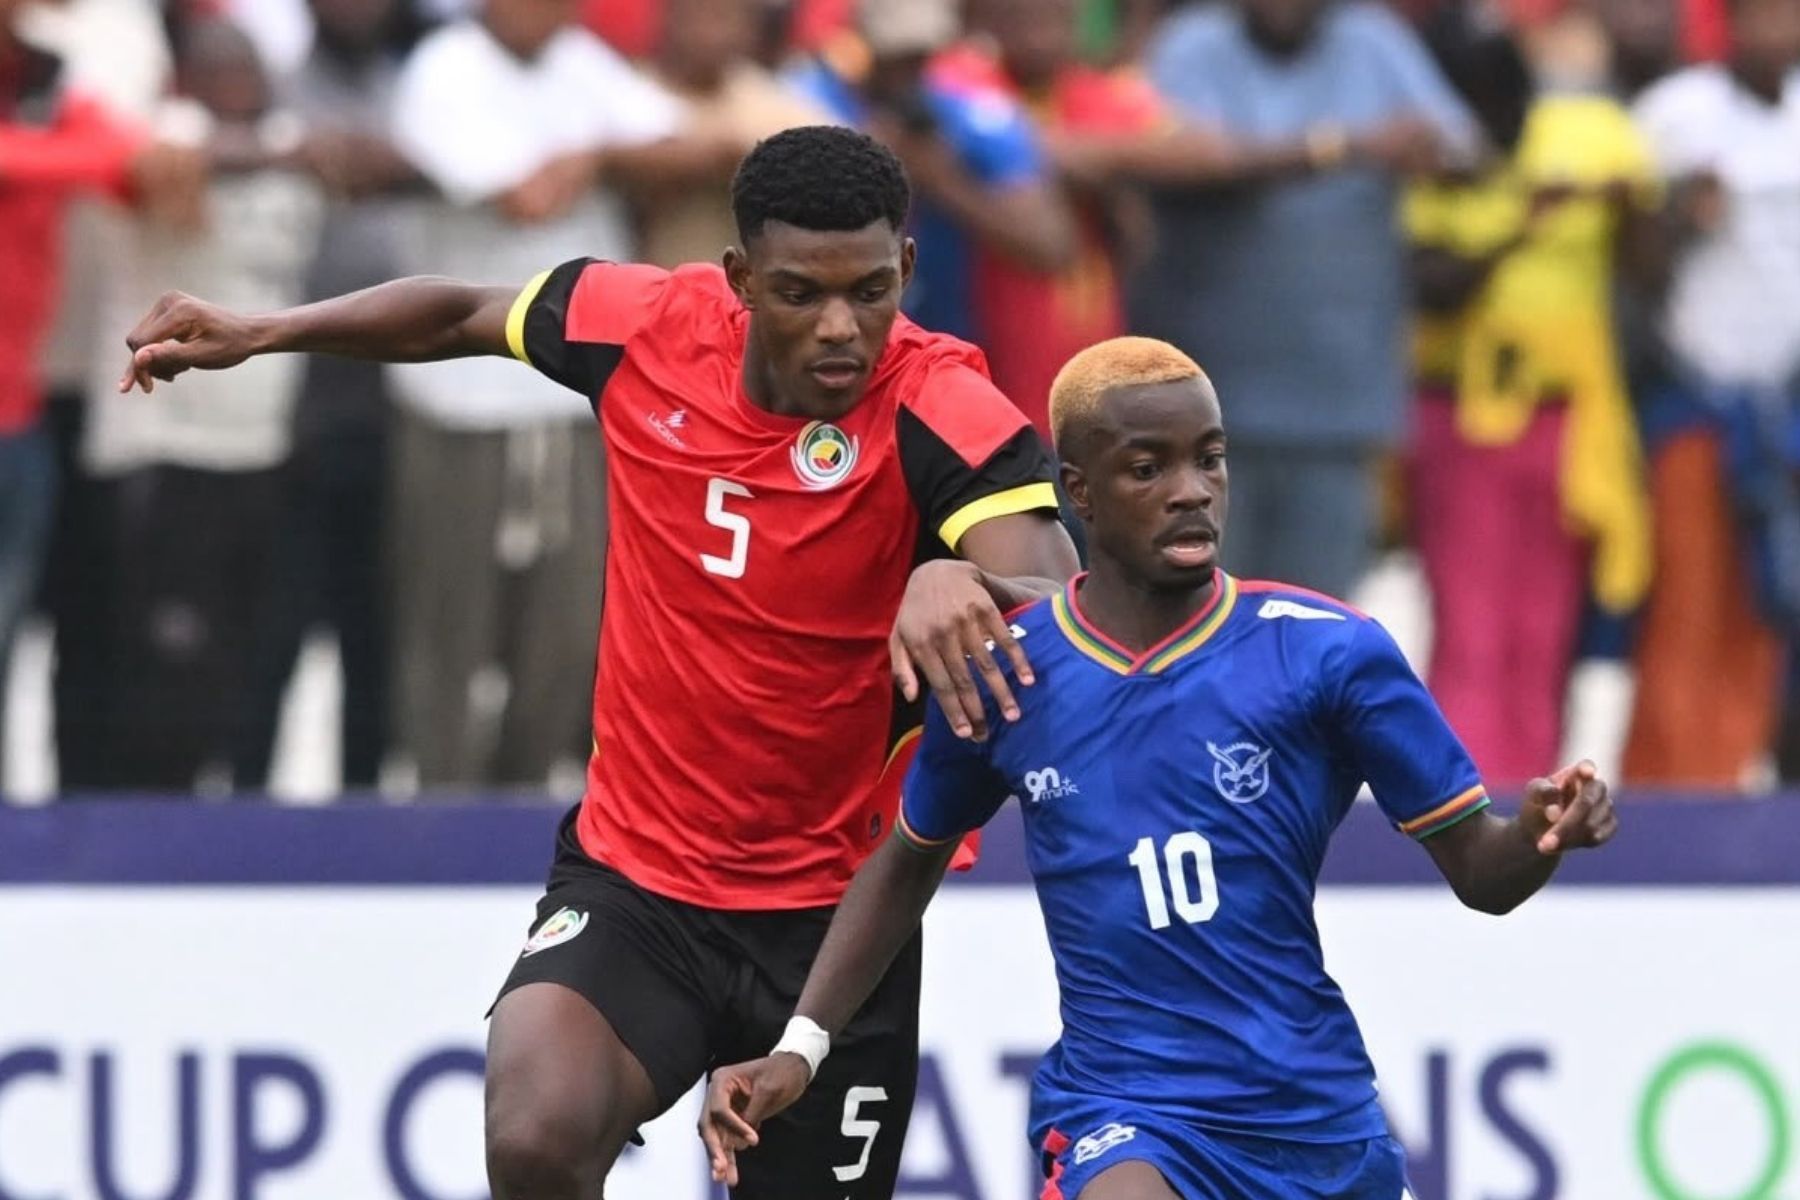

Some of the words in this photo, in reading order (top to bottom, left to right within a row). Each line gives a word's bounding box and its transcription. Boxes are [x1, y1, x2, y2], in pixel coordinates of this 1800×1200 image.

[700, 477, 755, 579] 5
[1128, 831, 1220, 930] 10
[832, 1086, 889, 1182] 5
